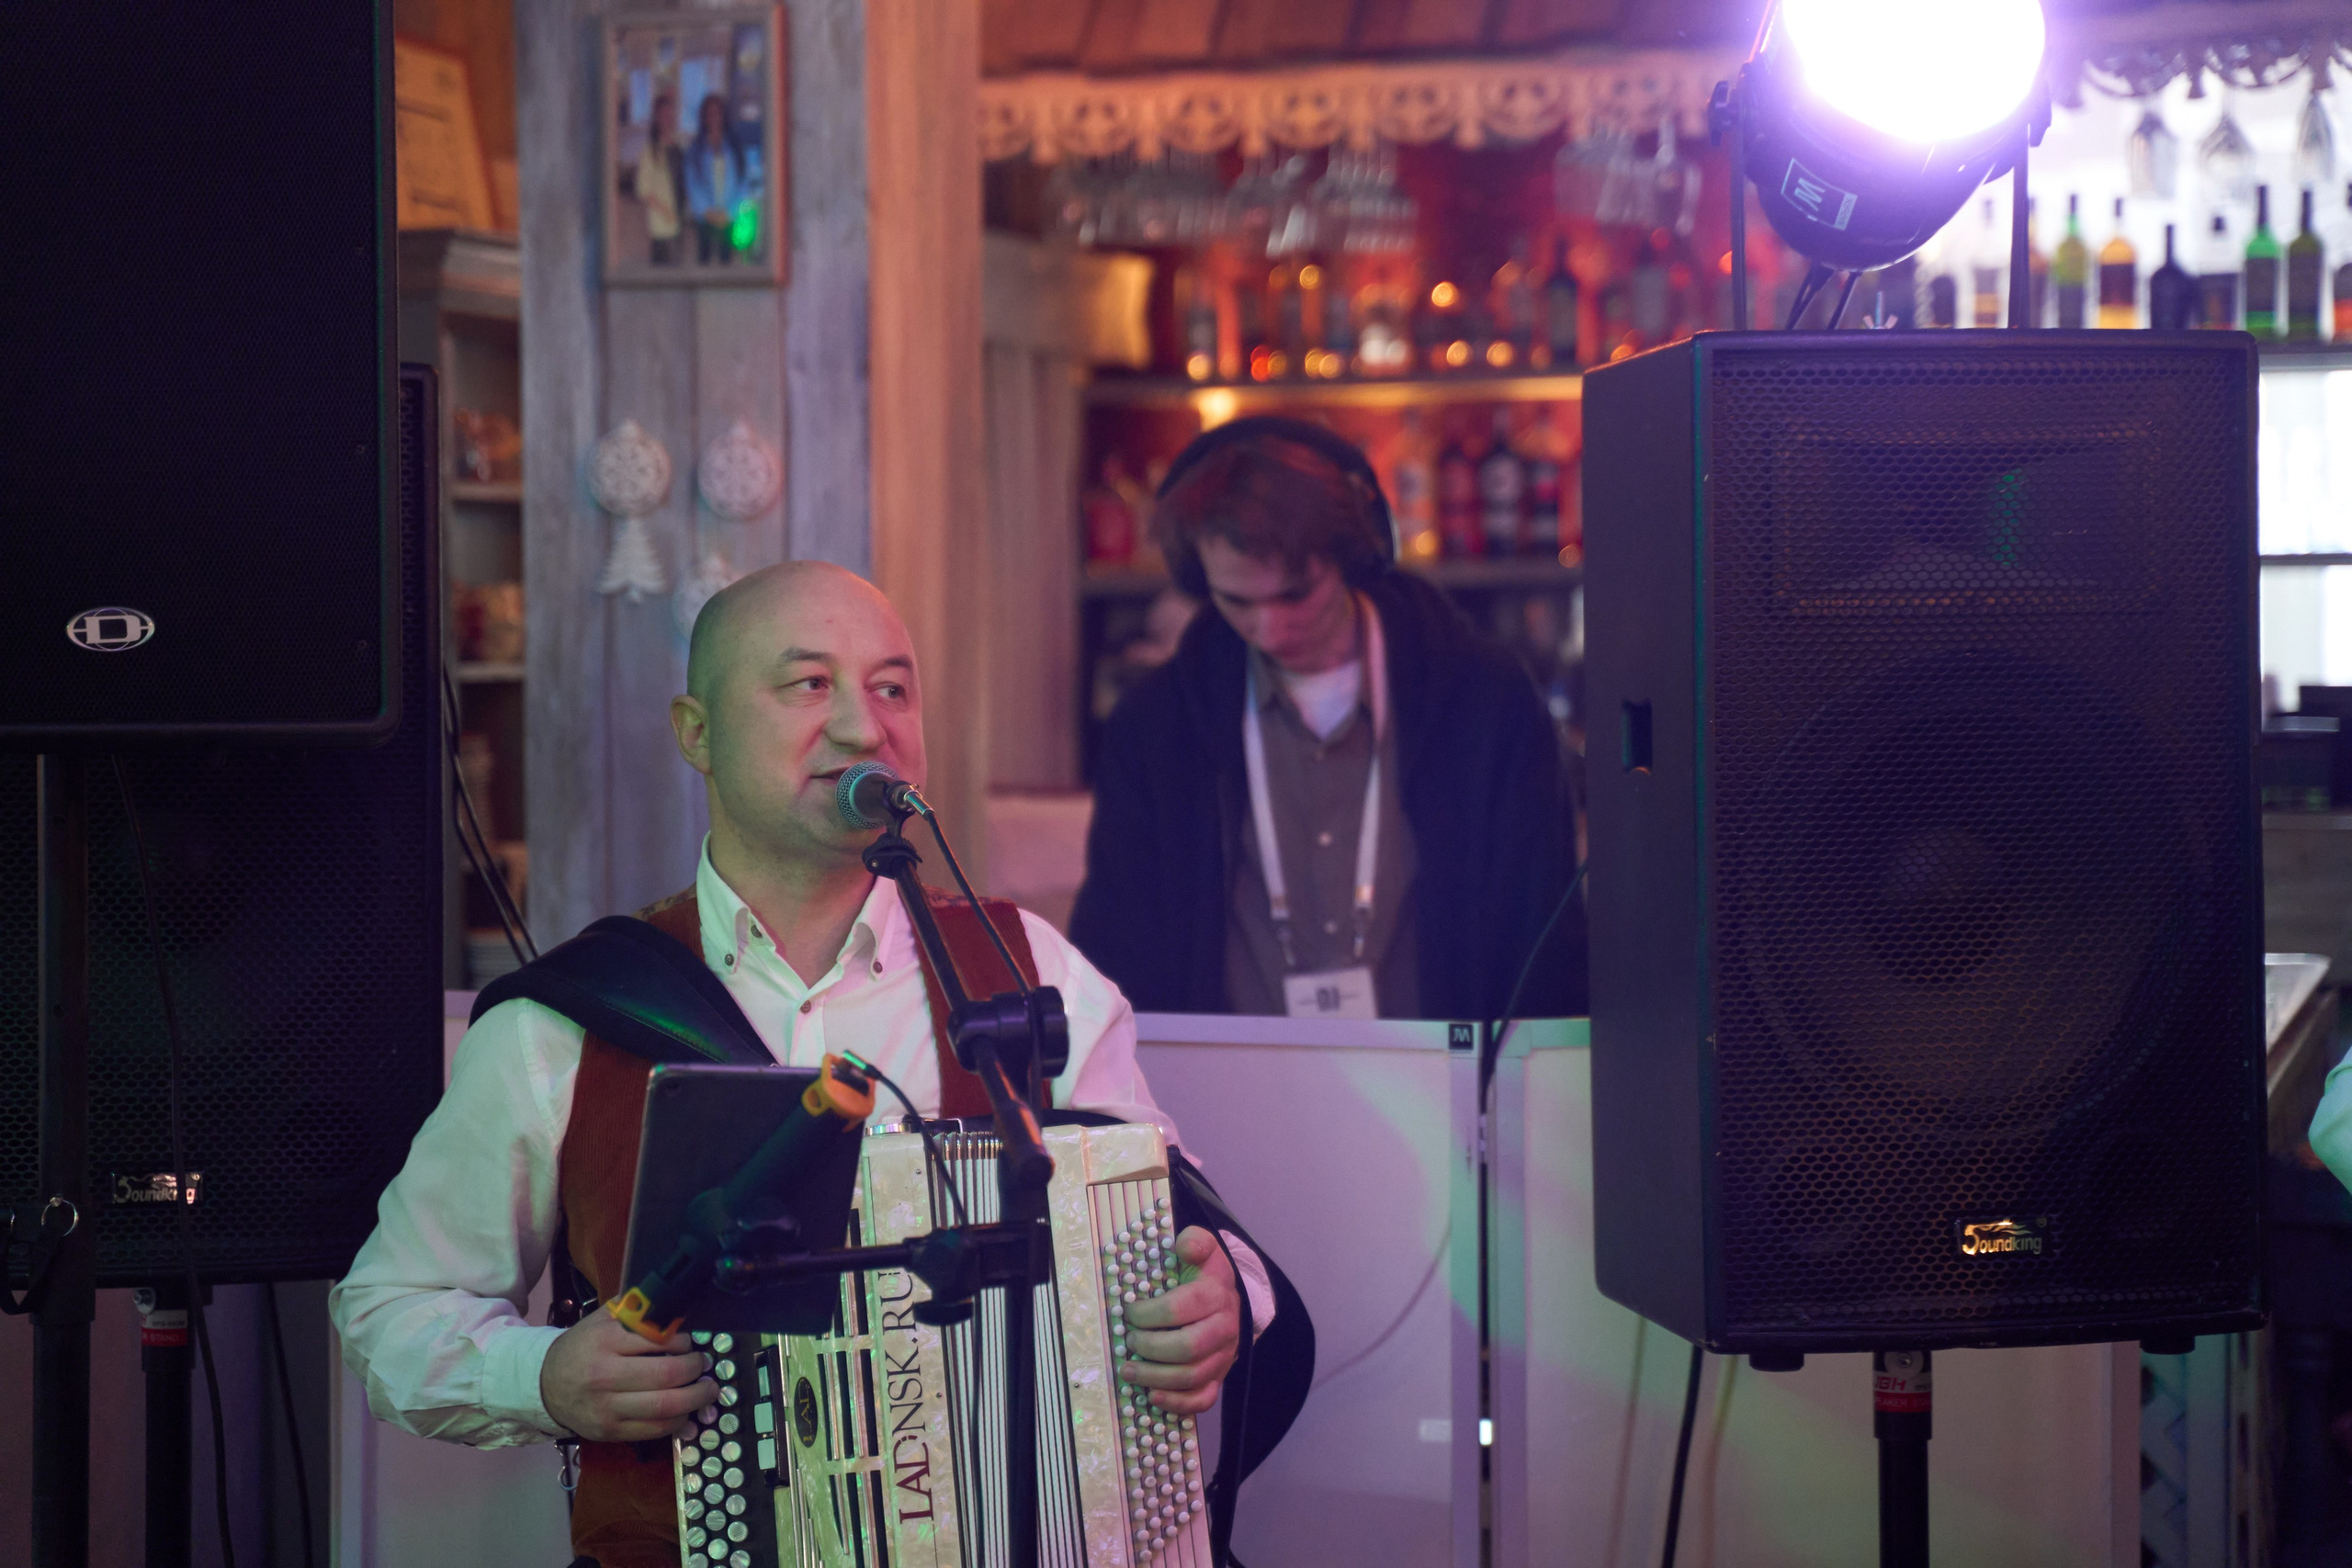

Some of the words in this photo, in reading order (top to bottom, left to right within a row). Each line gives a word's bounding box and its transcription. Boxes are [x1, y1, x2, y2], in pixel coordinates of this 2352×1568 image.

[116, 1176, 196, 1205] Soundkig
[1962, 1222, 2042, 1256] Soundking
[877, 1271, 934, 1525] LADNSK.RU
